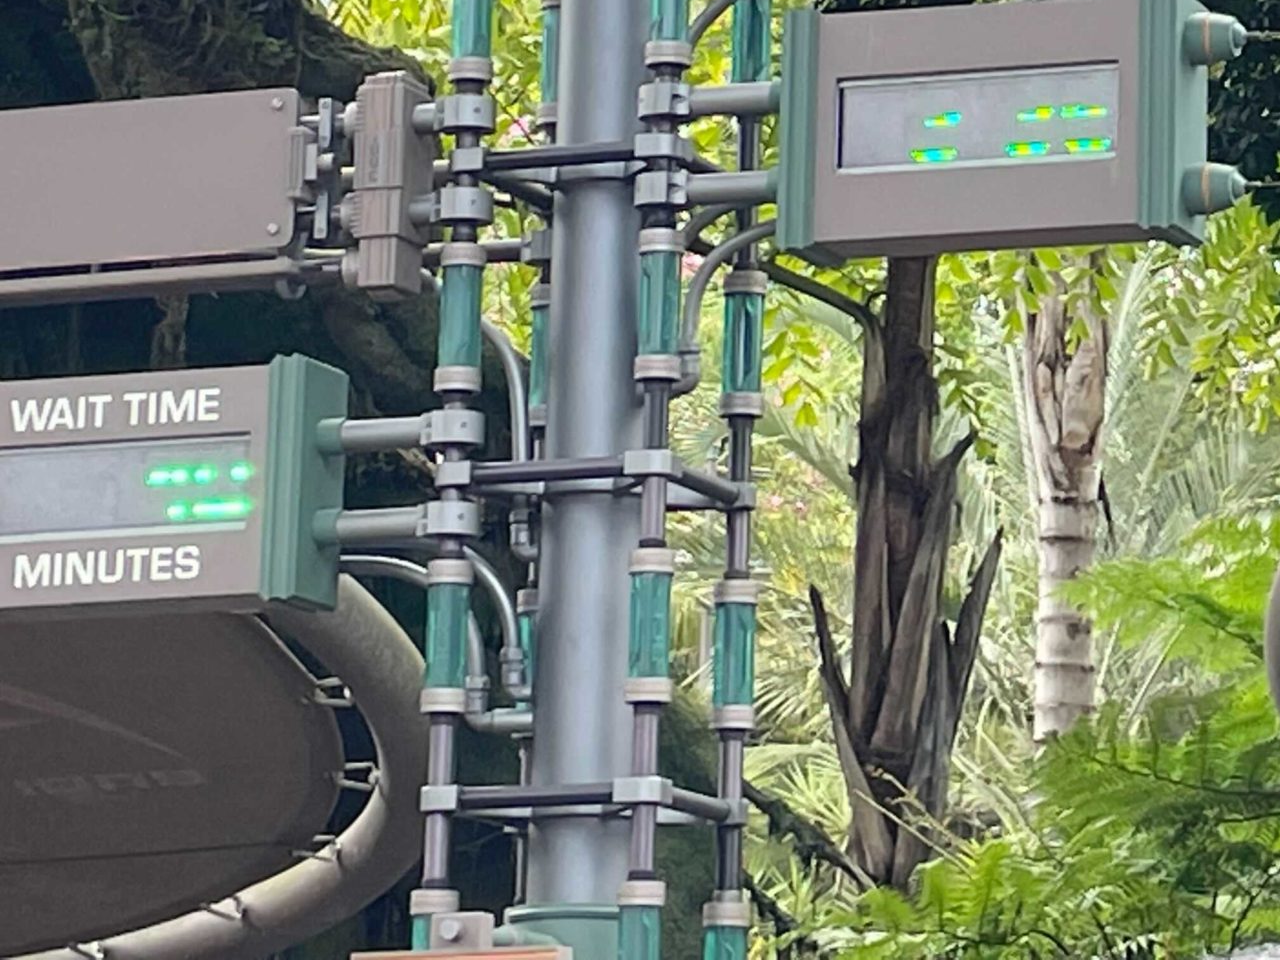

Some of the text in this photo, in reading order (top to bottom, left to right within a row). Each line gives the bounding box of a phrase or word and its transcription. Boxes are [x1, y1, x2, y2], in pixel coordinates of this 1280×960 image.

[10, 387, 221, 432] WAIT TIME
[13, 545, 201, 589] MINUTES
